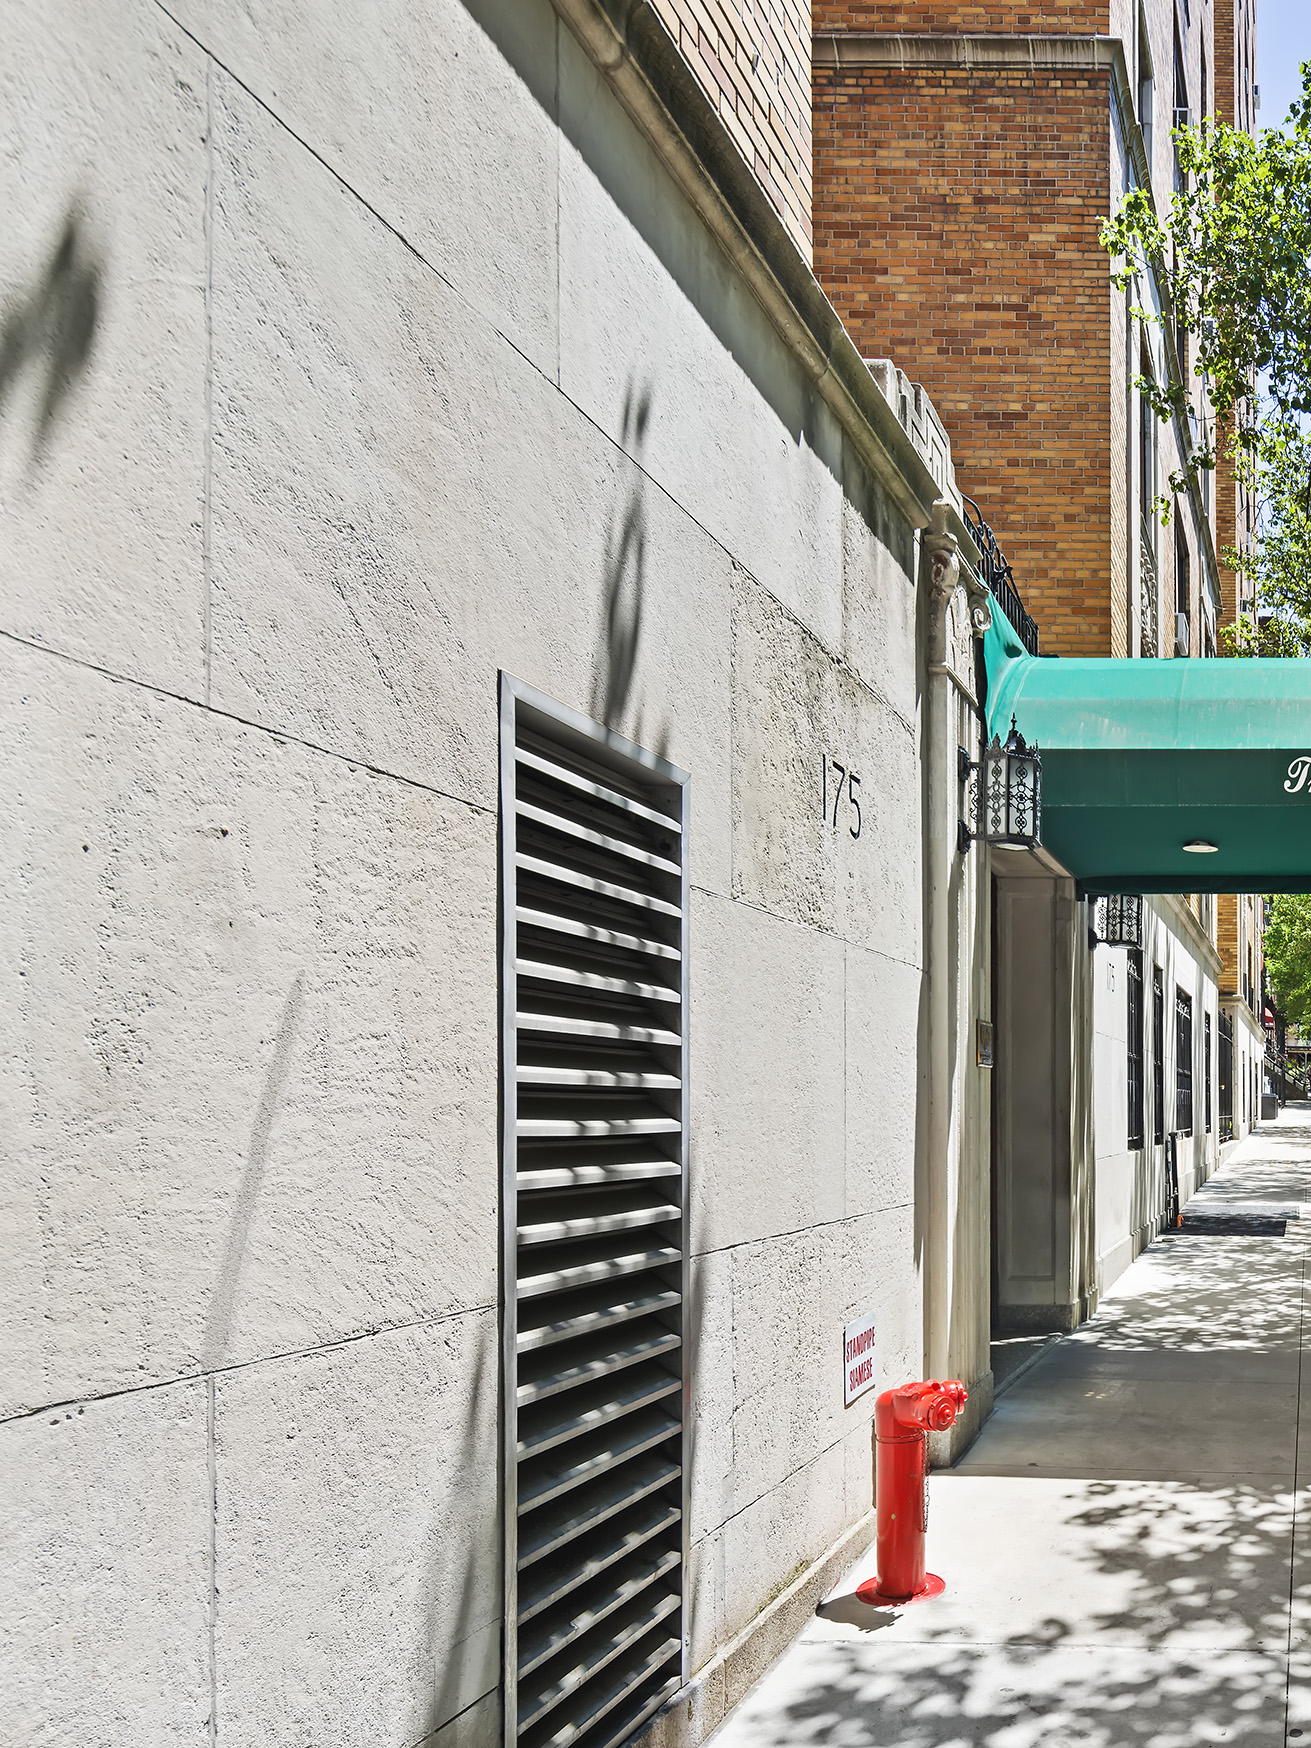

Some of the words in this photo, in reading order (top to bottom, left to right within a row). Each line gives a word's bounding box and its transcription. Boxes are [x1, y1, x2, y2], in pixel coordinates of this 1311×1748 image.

[822, 753, 861, 840] 175
[846, 1326, 875, 1363] STANDPIPE
[849, 1357, 873, 1392] SIAMESE
